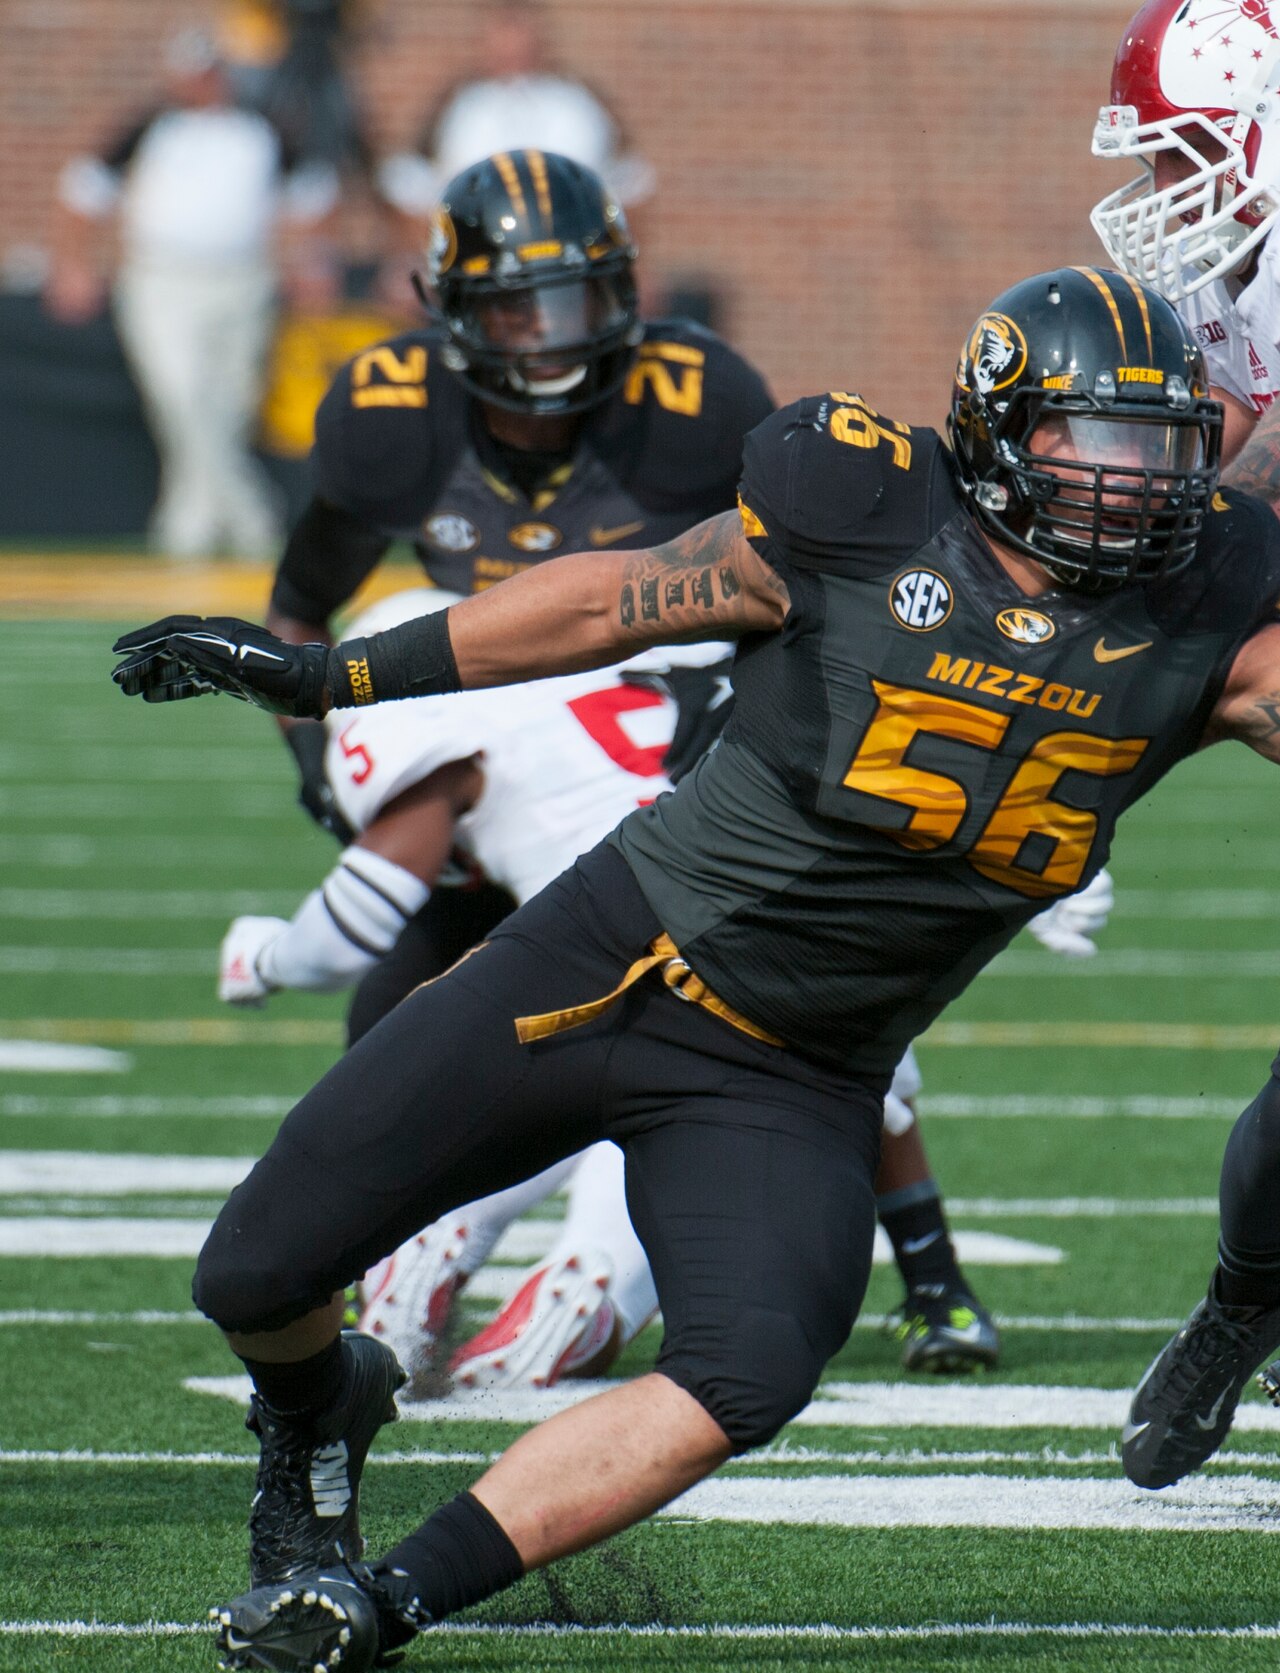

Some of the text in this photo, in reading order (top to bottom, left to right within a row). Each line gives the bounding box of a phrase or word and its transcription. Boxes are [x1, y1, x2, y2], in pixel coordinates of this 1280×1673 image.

[1117, 366, 1164, 385] TIGERS
[894, 572, 949, 627] SEC
[927, 652, 1103, 718] MIZZOU
[842, 679, 1149, 898] 56
